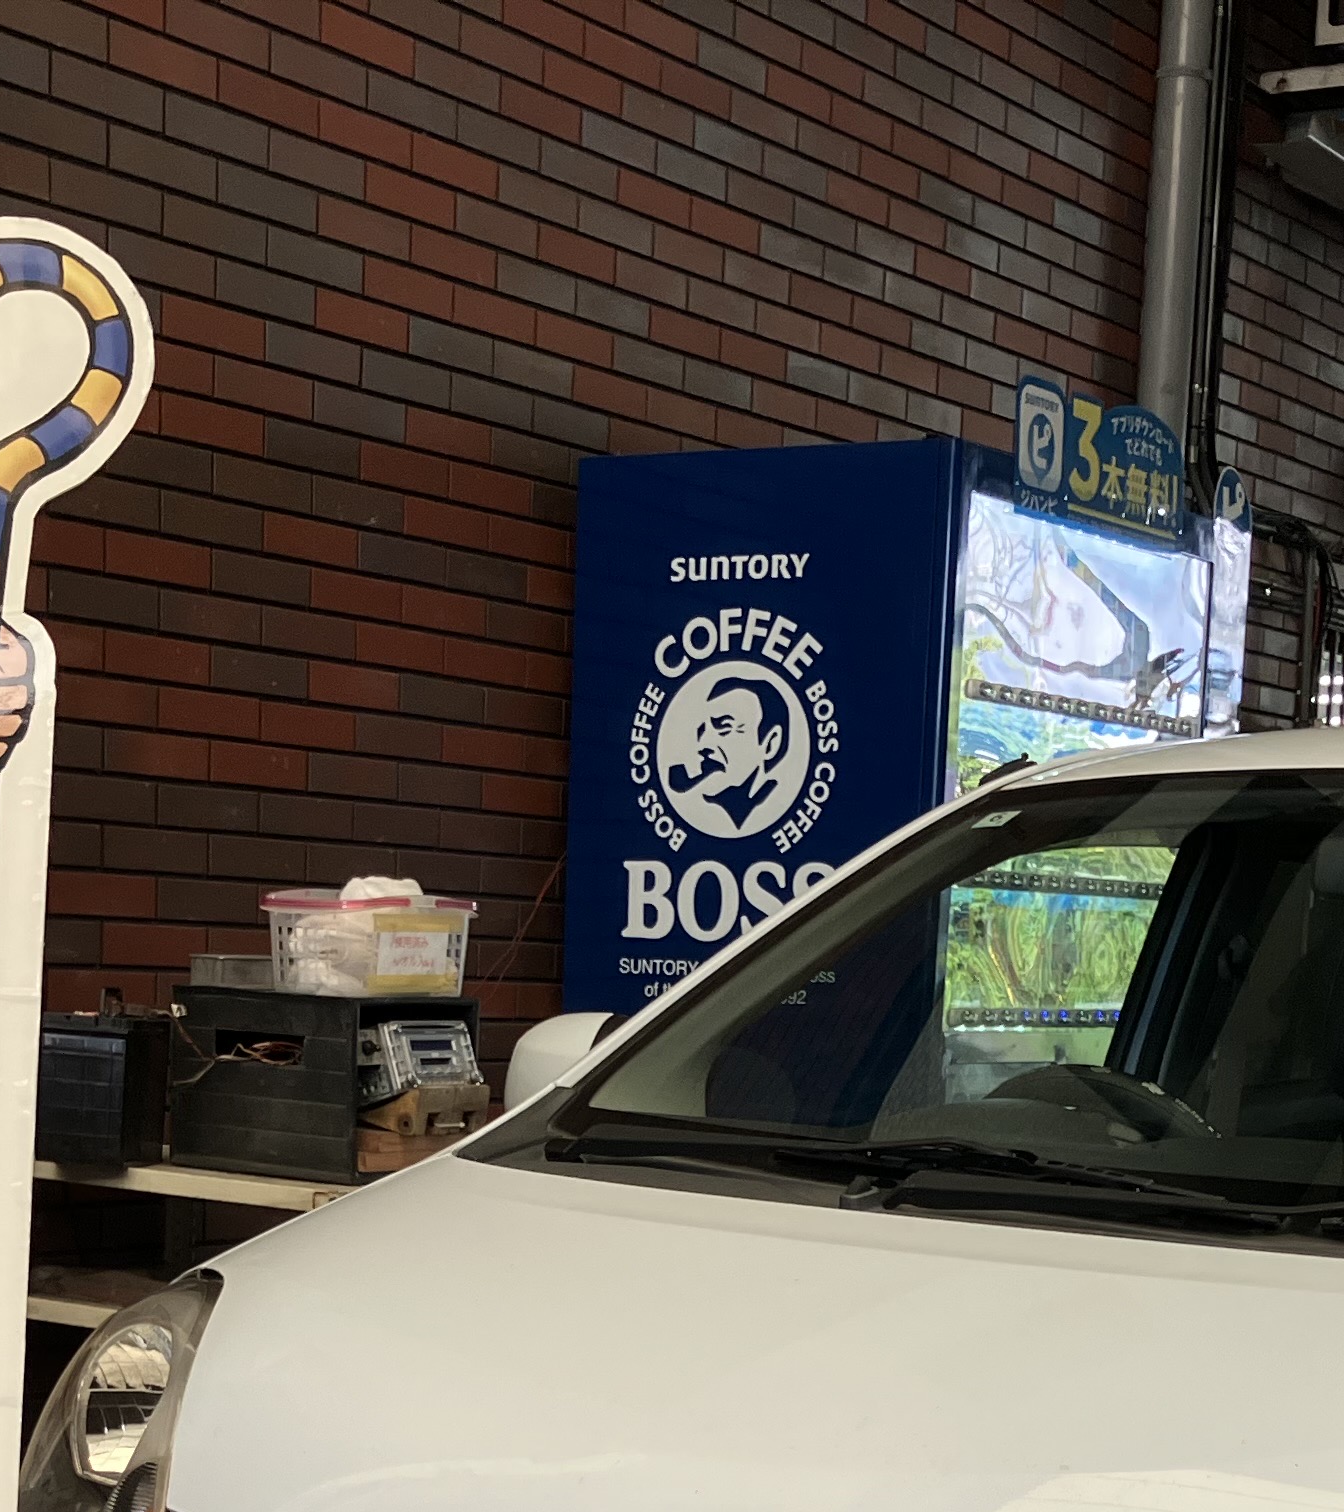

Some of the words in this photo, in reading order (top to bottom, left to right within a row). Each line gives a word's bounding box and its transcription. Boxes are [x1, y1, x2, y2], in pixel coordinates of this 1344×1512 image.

[670, 552, 810, 583] SUNTORY
[654, 607, 824, 681] COFFEE
[629, 682, 666, 785] COFFEE
[804, 679, 840, 754] BOSS
[638, 788, 687, 853] BOSS
[771, 761, 837, 854] COFFEE
[618, 957, 700, 976] SUNTORY
[644, 981, 659, 998] of
